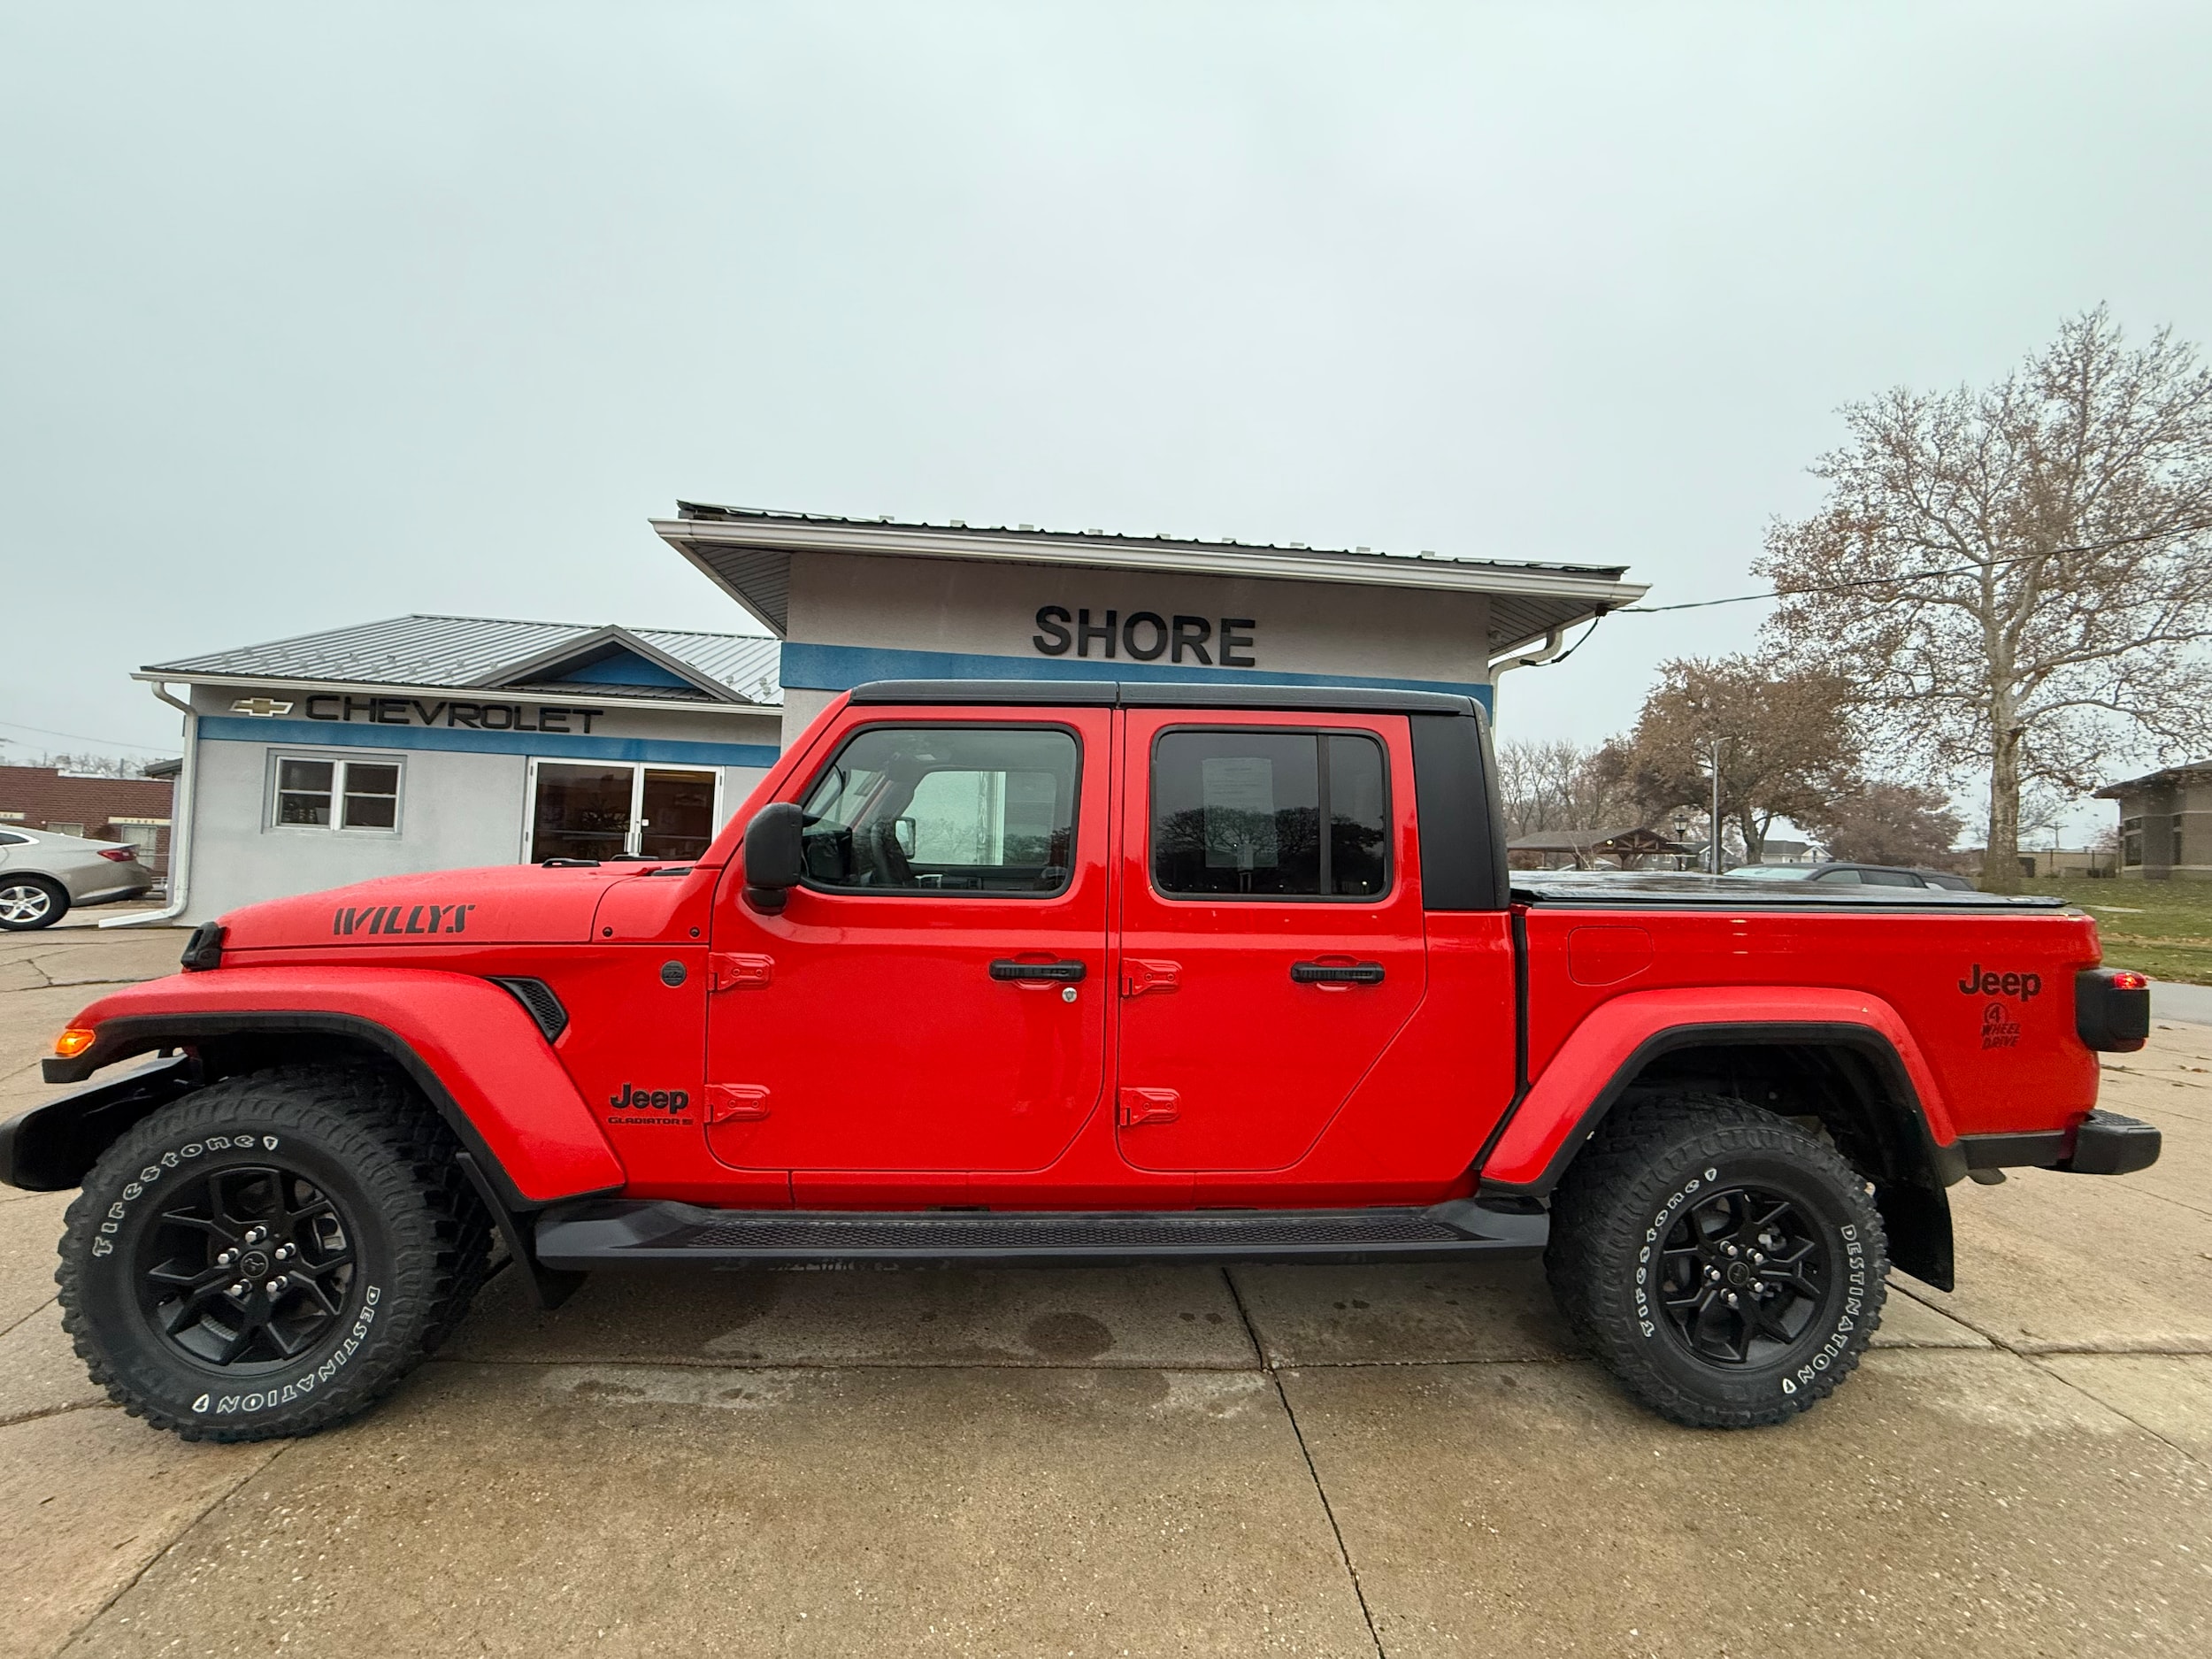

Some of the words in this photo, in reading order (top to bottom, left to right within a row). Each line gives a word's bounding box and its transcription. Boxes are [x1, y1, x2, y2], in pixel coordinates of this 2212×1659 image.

[1032, 605, 1256, 667] SHORE
[305, 694, 604, 734] CHEVROLET
[333, 904, 476, 935] WILLYS
[1958, 964, 2042, 1002] Jeep
[1981, 1023, 2022, 1036] WHEEL
[1981, 1035, 2020, 1050] DRIVE
[610, 1082, 689, 1115] Jeep
[607, 1117, 680, 1125] GLADIATOR
[1797, 1224, 1865, 1386] DESTINATION
[215, 1284, 382, 1415] DESTINATION
